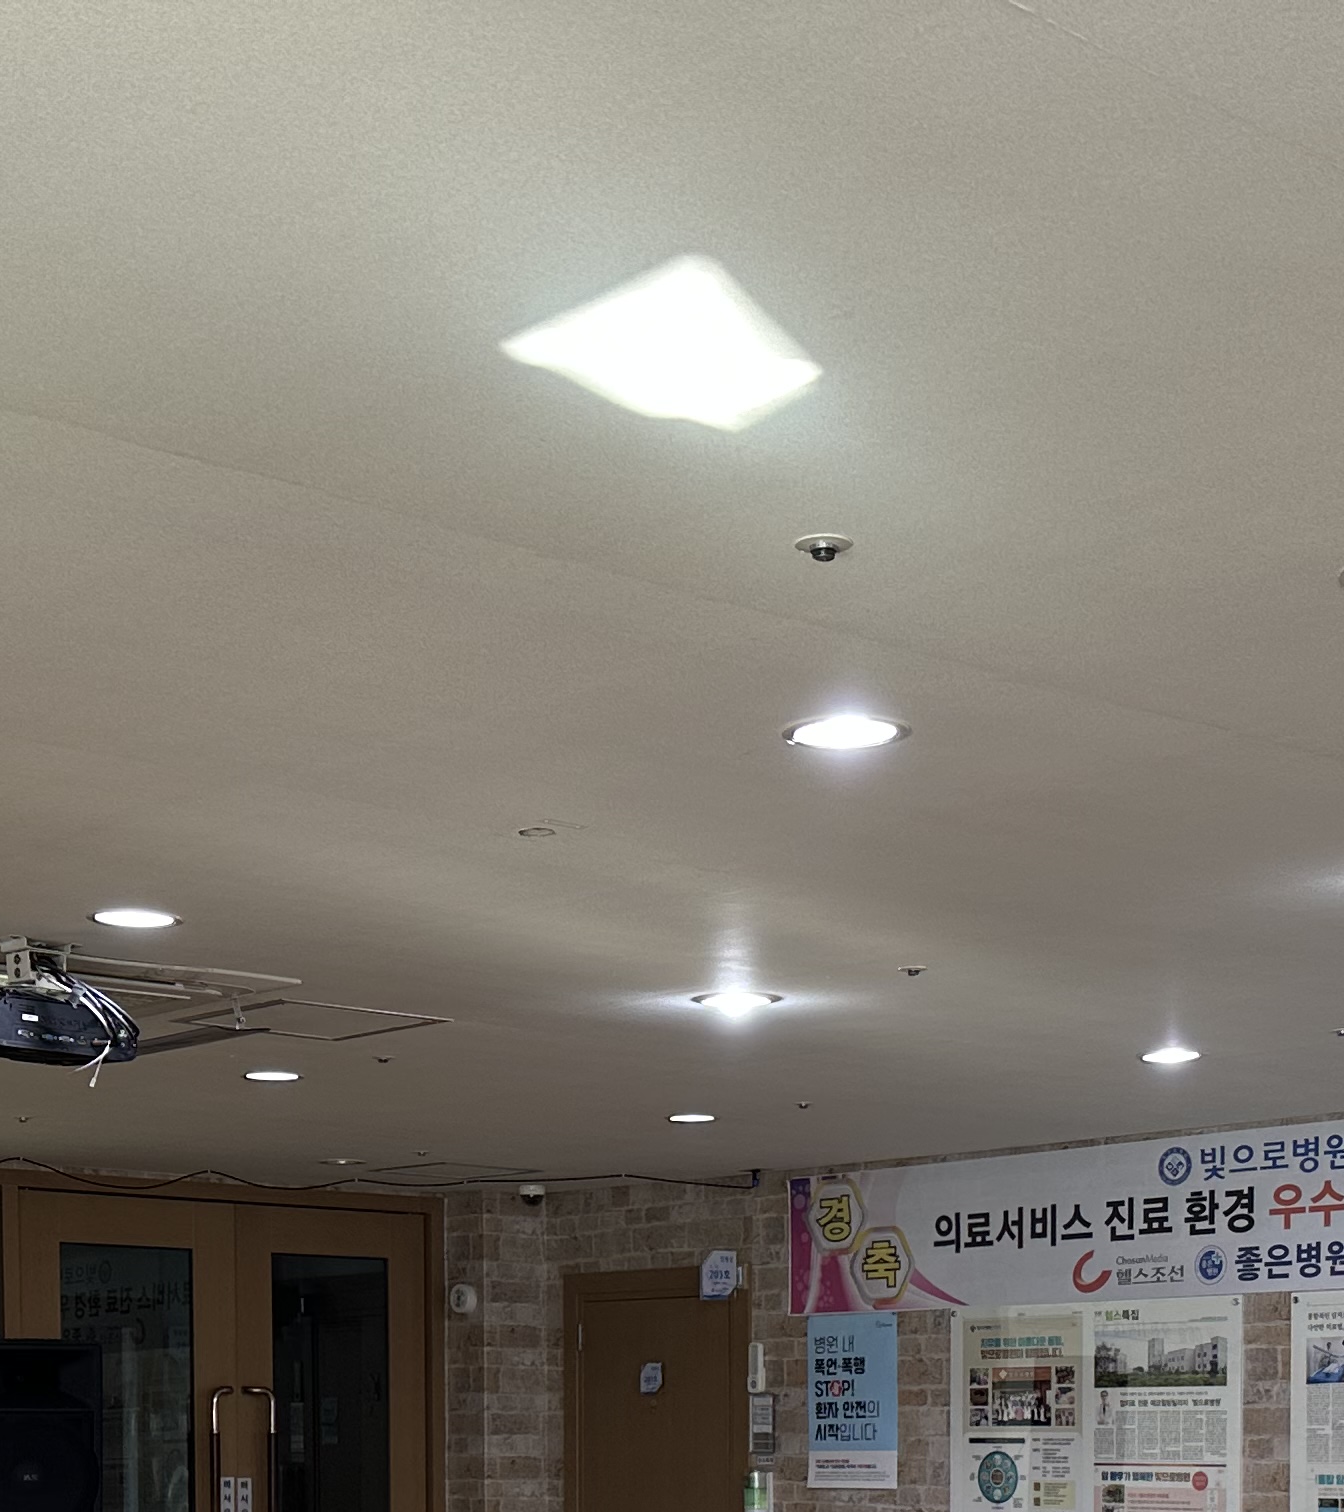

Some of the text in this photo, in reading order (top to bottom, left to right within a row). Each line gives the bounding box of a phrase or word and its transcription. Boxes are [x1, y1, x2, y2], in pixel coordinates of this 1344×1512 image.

[816, 1193, 852, 1243] 경
[933, 1203, 1095, 1253] 의료서비스
[1104, 1196, 1172, 1243] 진료
[1184, 1187, 1256, 1234] 환경
[862, 1240, 900, 1289] 축
[1115, 1263, 1185, 1286] 헬스조선
[814, 1335, 855, 1354] 병원 내
[814, 1379, 855, 1397] STOP!
[815, 1400, 880, 1420] 환자 안전의
[815, 1422, 878, 1442] 시작입니다
